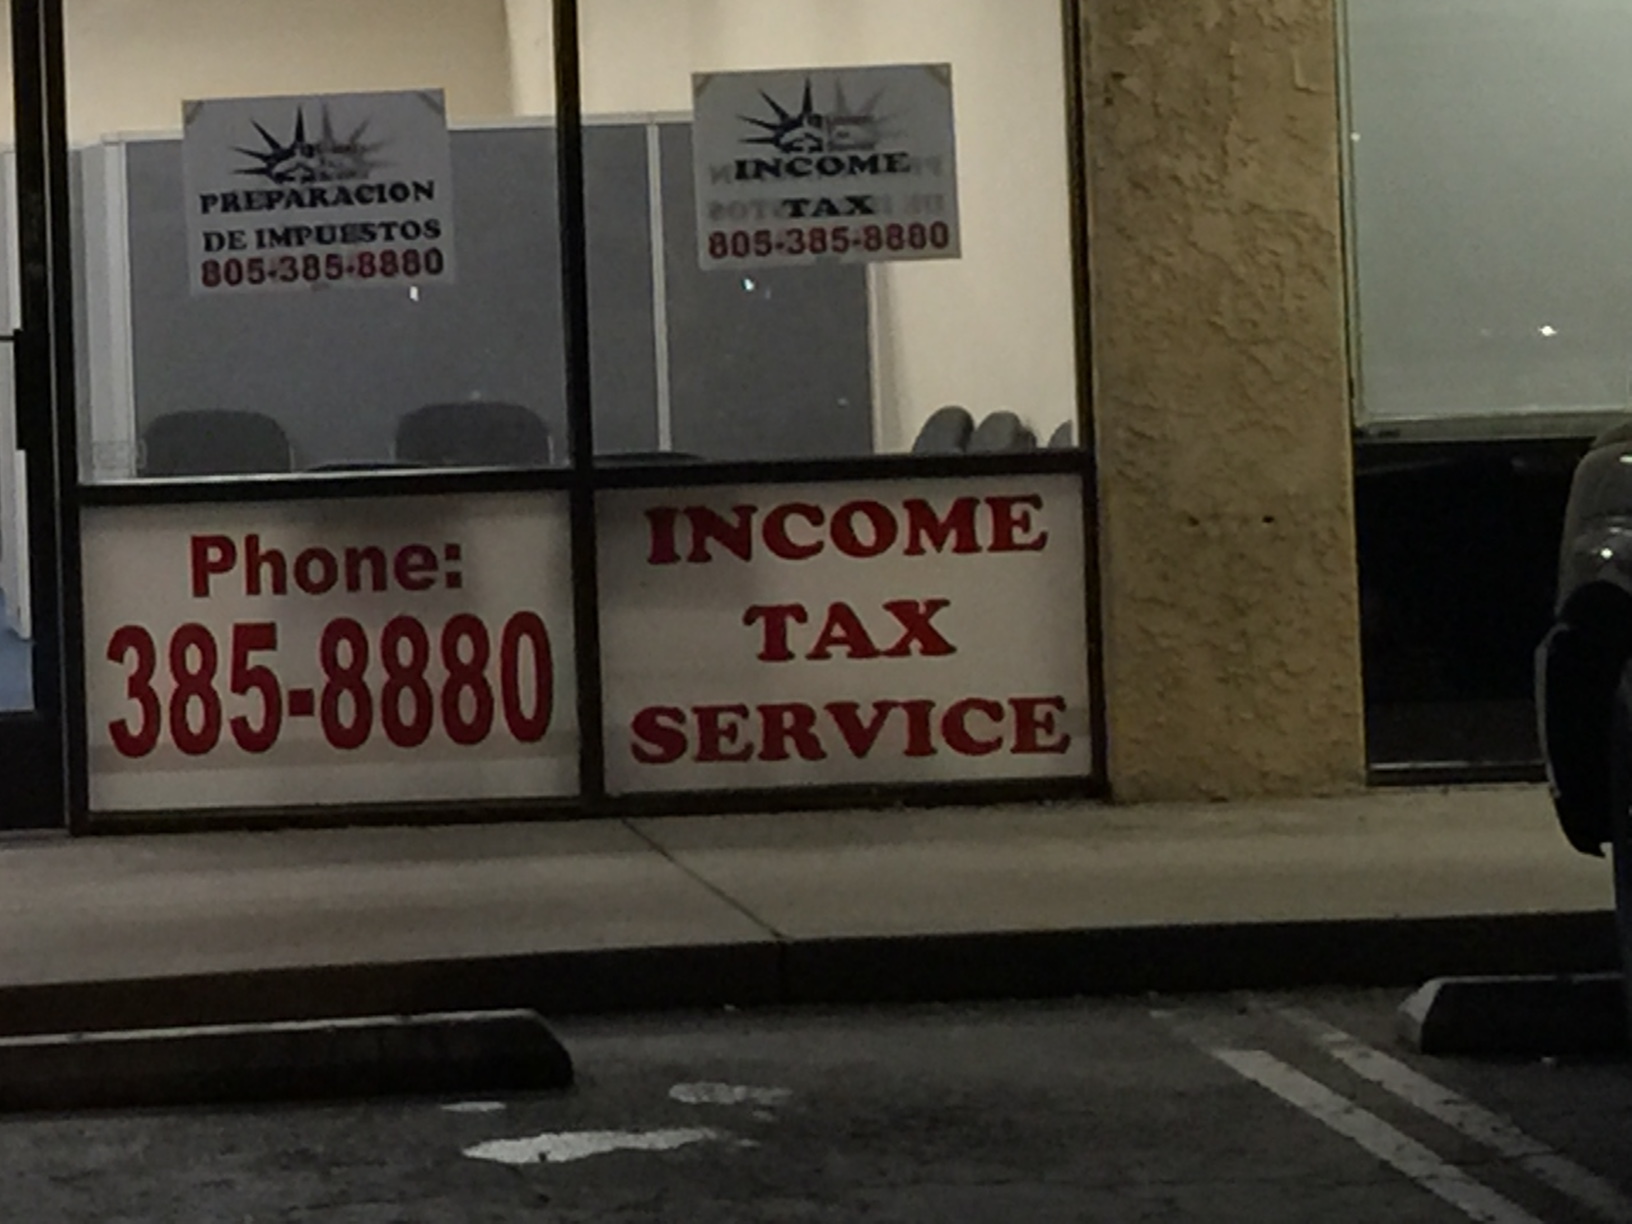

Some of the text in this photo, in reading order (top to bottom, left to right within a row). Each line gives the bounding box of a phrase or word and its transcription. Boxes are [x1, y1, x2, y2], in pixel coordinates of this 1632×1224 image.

[734, 152, 911, 180] INCOME
[200, 181, 435, 214] PREPARACION
[782, 194, 876, 219] TAX
[203, 219, 441, 253] DE IMPUESTOS
[708, 221, 949, 259] 805-385-8880
[200, 247, 444, 288] 805-385-8880
[644, 494, 1048, 565] INCOME
[190, 534, 463, 598] Phone:
[742, 598, 957, 662] TAX
[106, 610, 554, 759] 385-8880
[630, 695, 1070, 765] SERVICE
